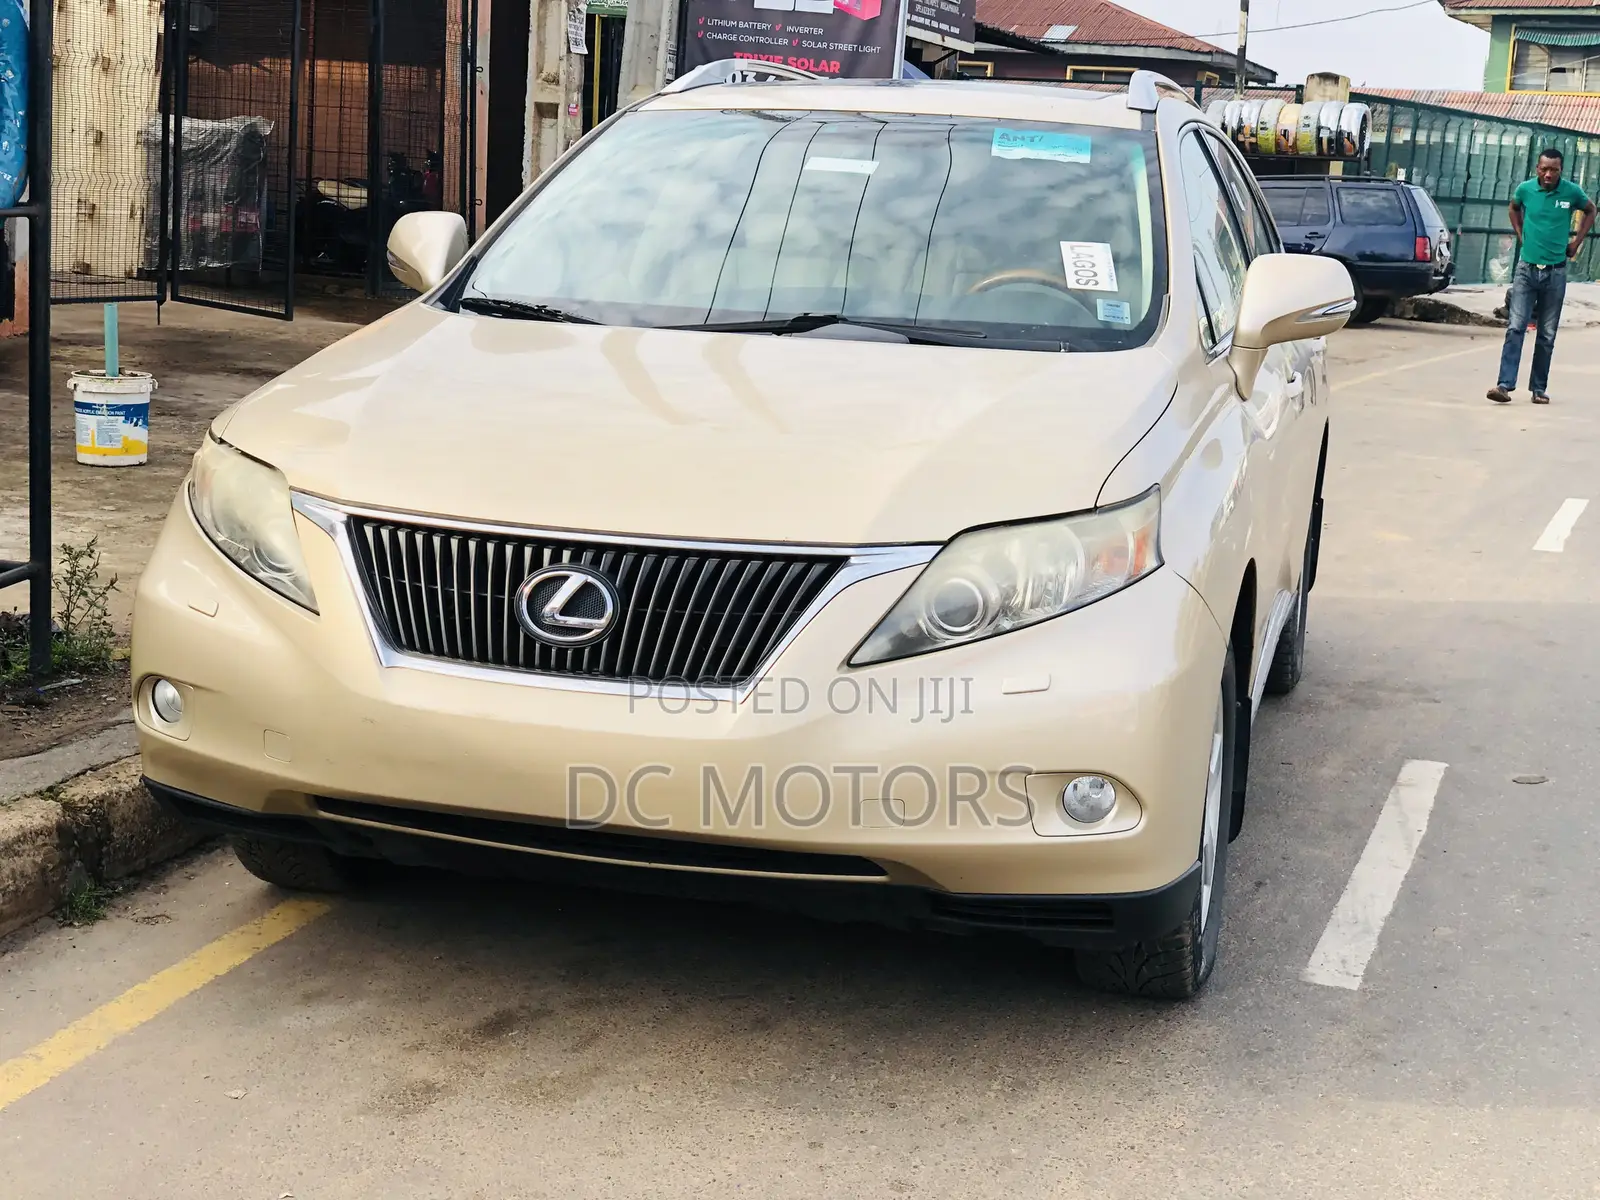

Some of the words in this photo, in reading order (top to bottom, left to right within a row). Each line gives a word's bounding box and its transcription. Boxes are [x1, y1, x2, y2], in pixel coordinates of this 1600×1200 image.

[707, 18, 737, 28] LITHIUM
[738, 20, 772, 31] BATTERY
[786, 25, 824, 35] INVERTER
[706, 31, 737, 41] CHARGE
[738, 35, 789, 46] CONTROLLER
[802, 40, 828, 50] SOLAR
[828, 42, 858, 52] STREET
[858, 45, 881, 54] LIGHT
[787, 56, 841, 73] SOLAR
[1069, 244, 1100, 287] LAGOS
